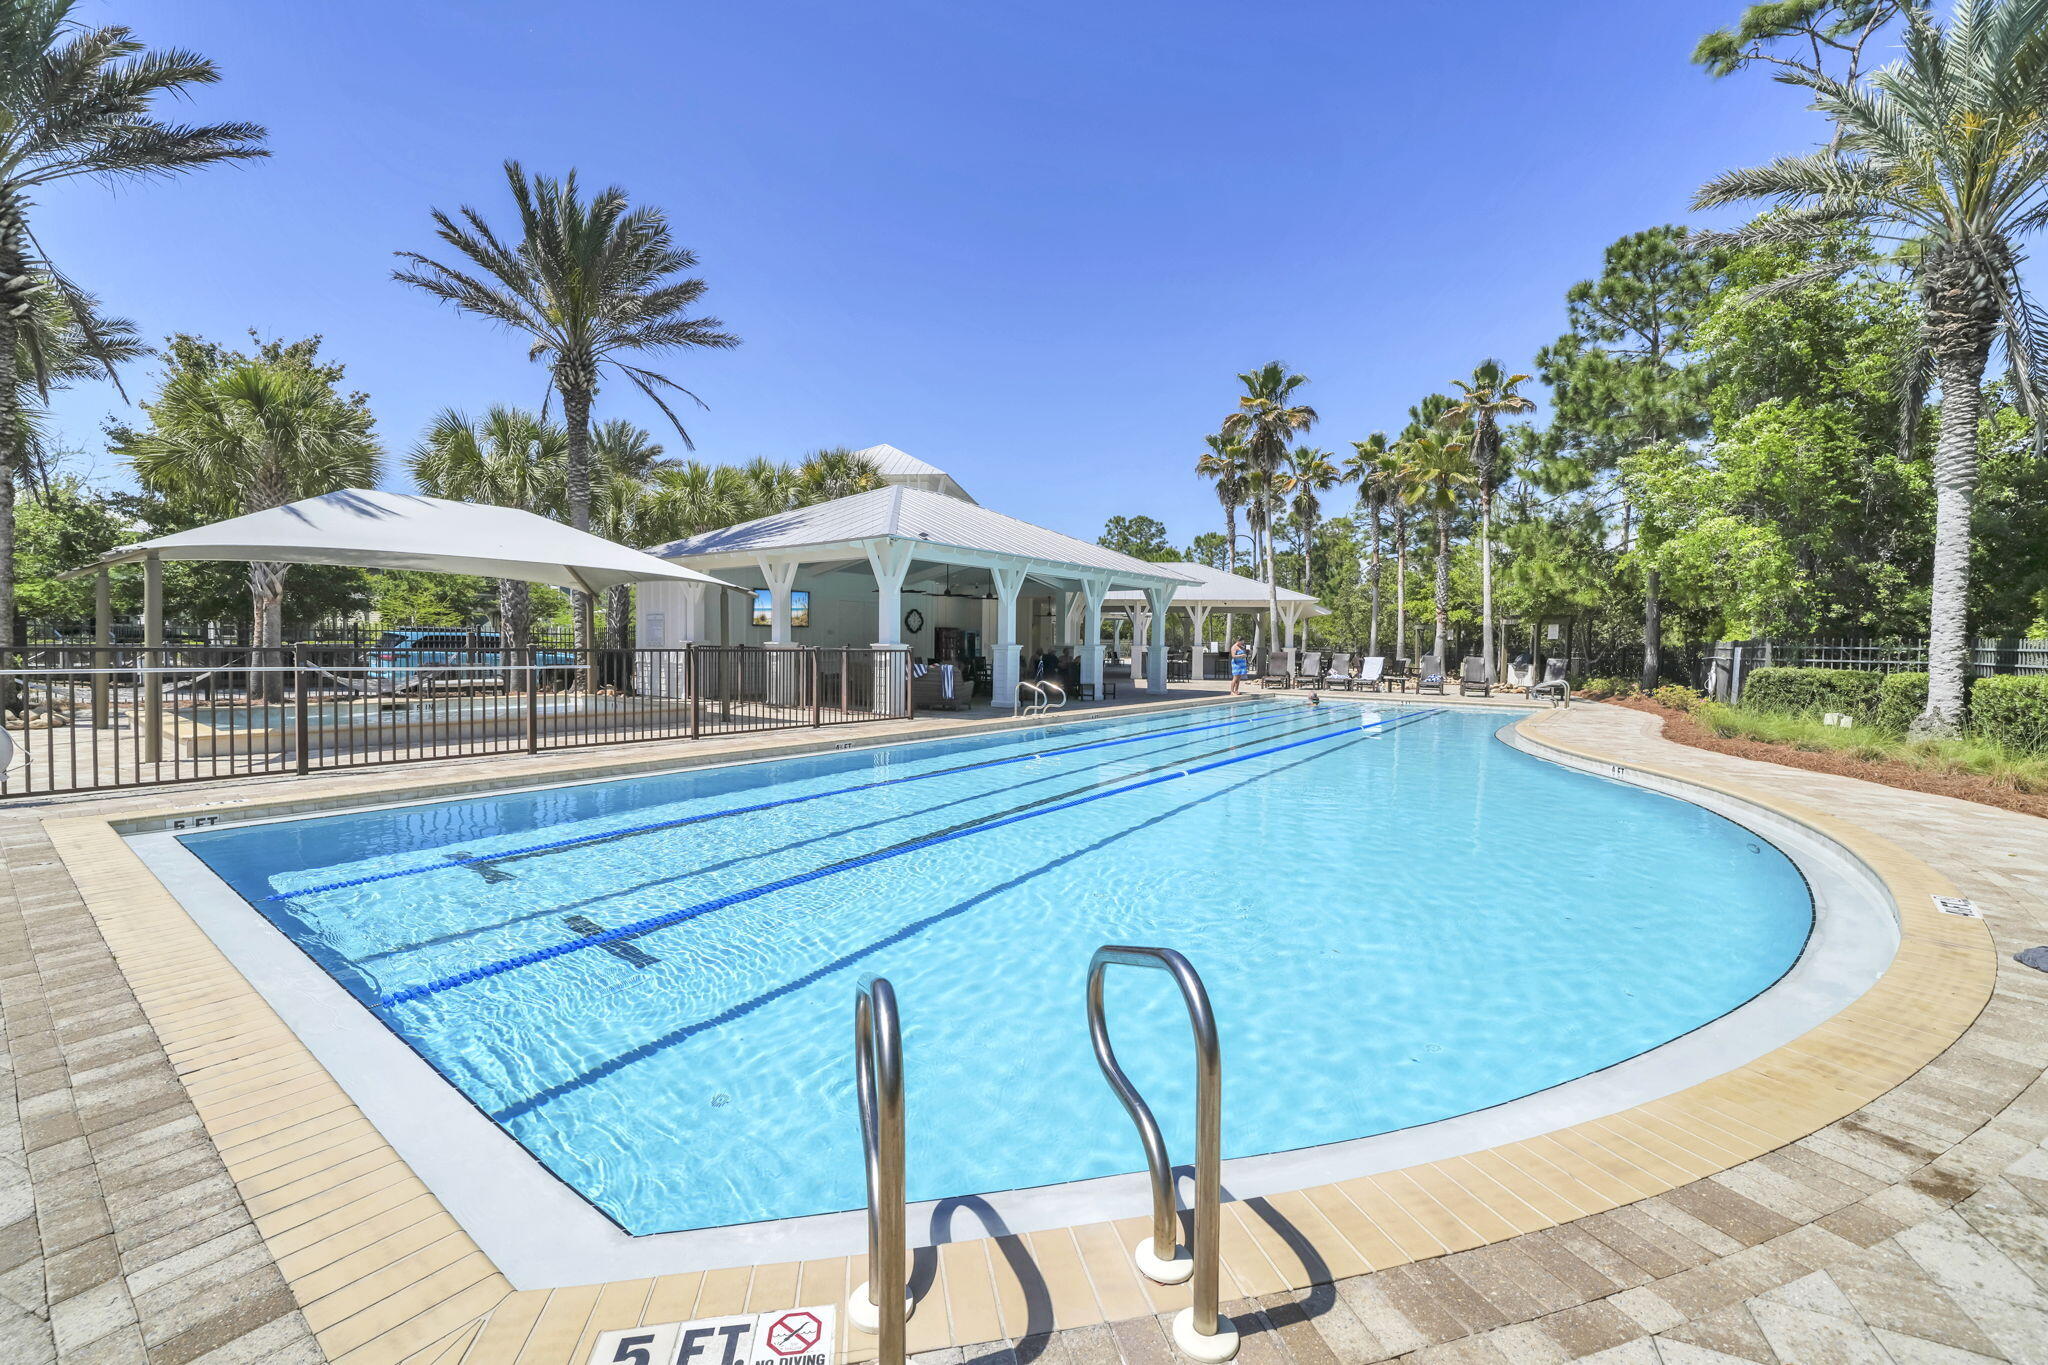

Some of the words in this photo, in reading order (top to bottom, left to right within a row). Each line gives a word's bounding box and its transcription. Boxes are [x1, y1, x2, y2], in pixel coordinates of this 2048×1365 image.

[195, 816, 218, 827] FT
[613, 1334, 655, 1365] 5
[780, 1353, 825, 1365] DIVING
